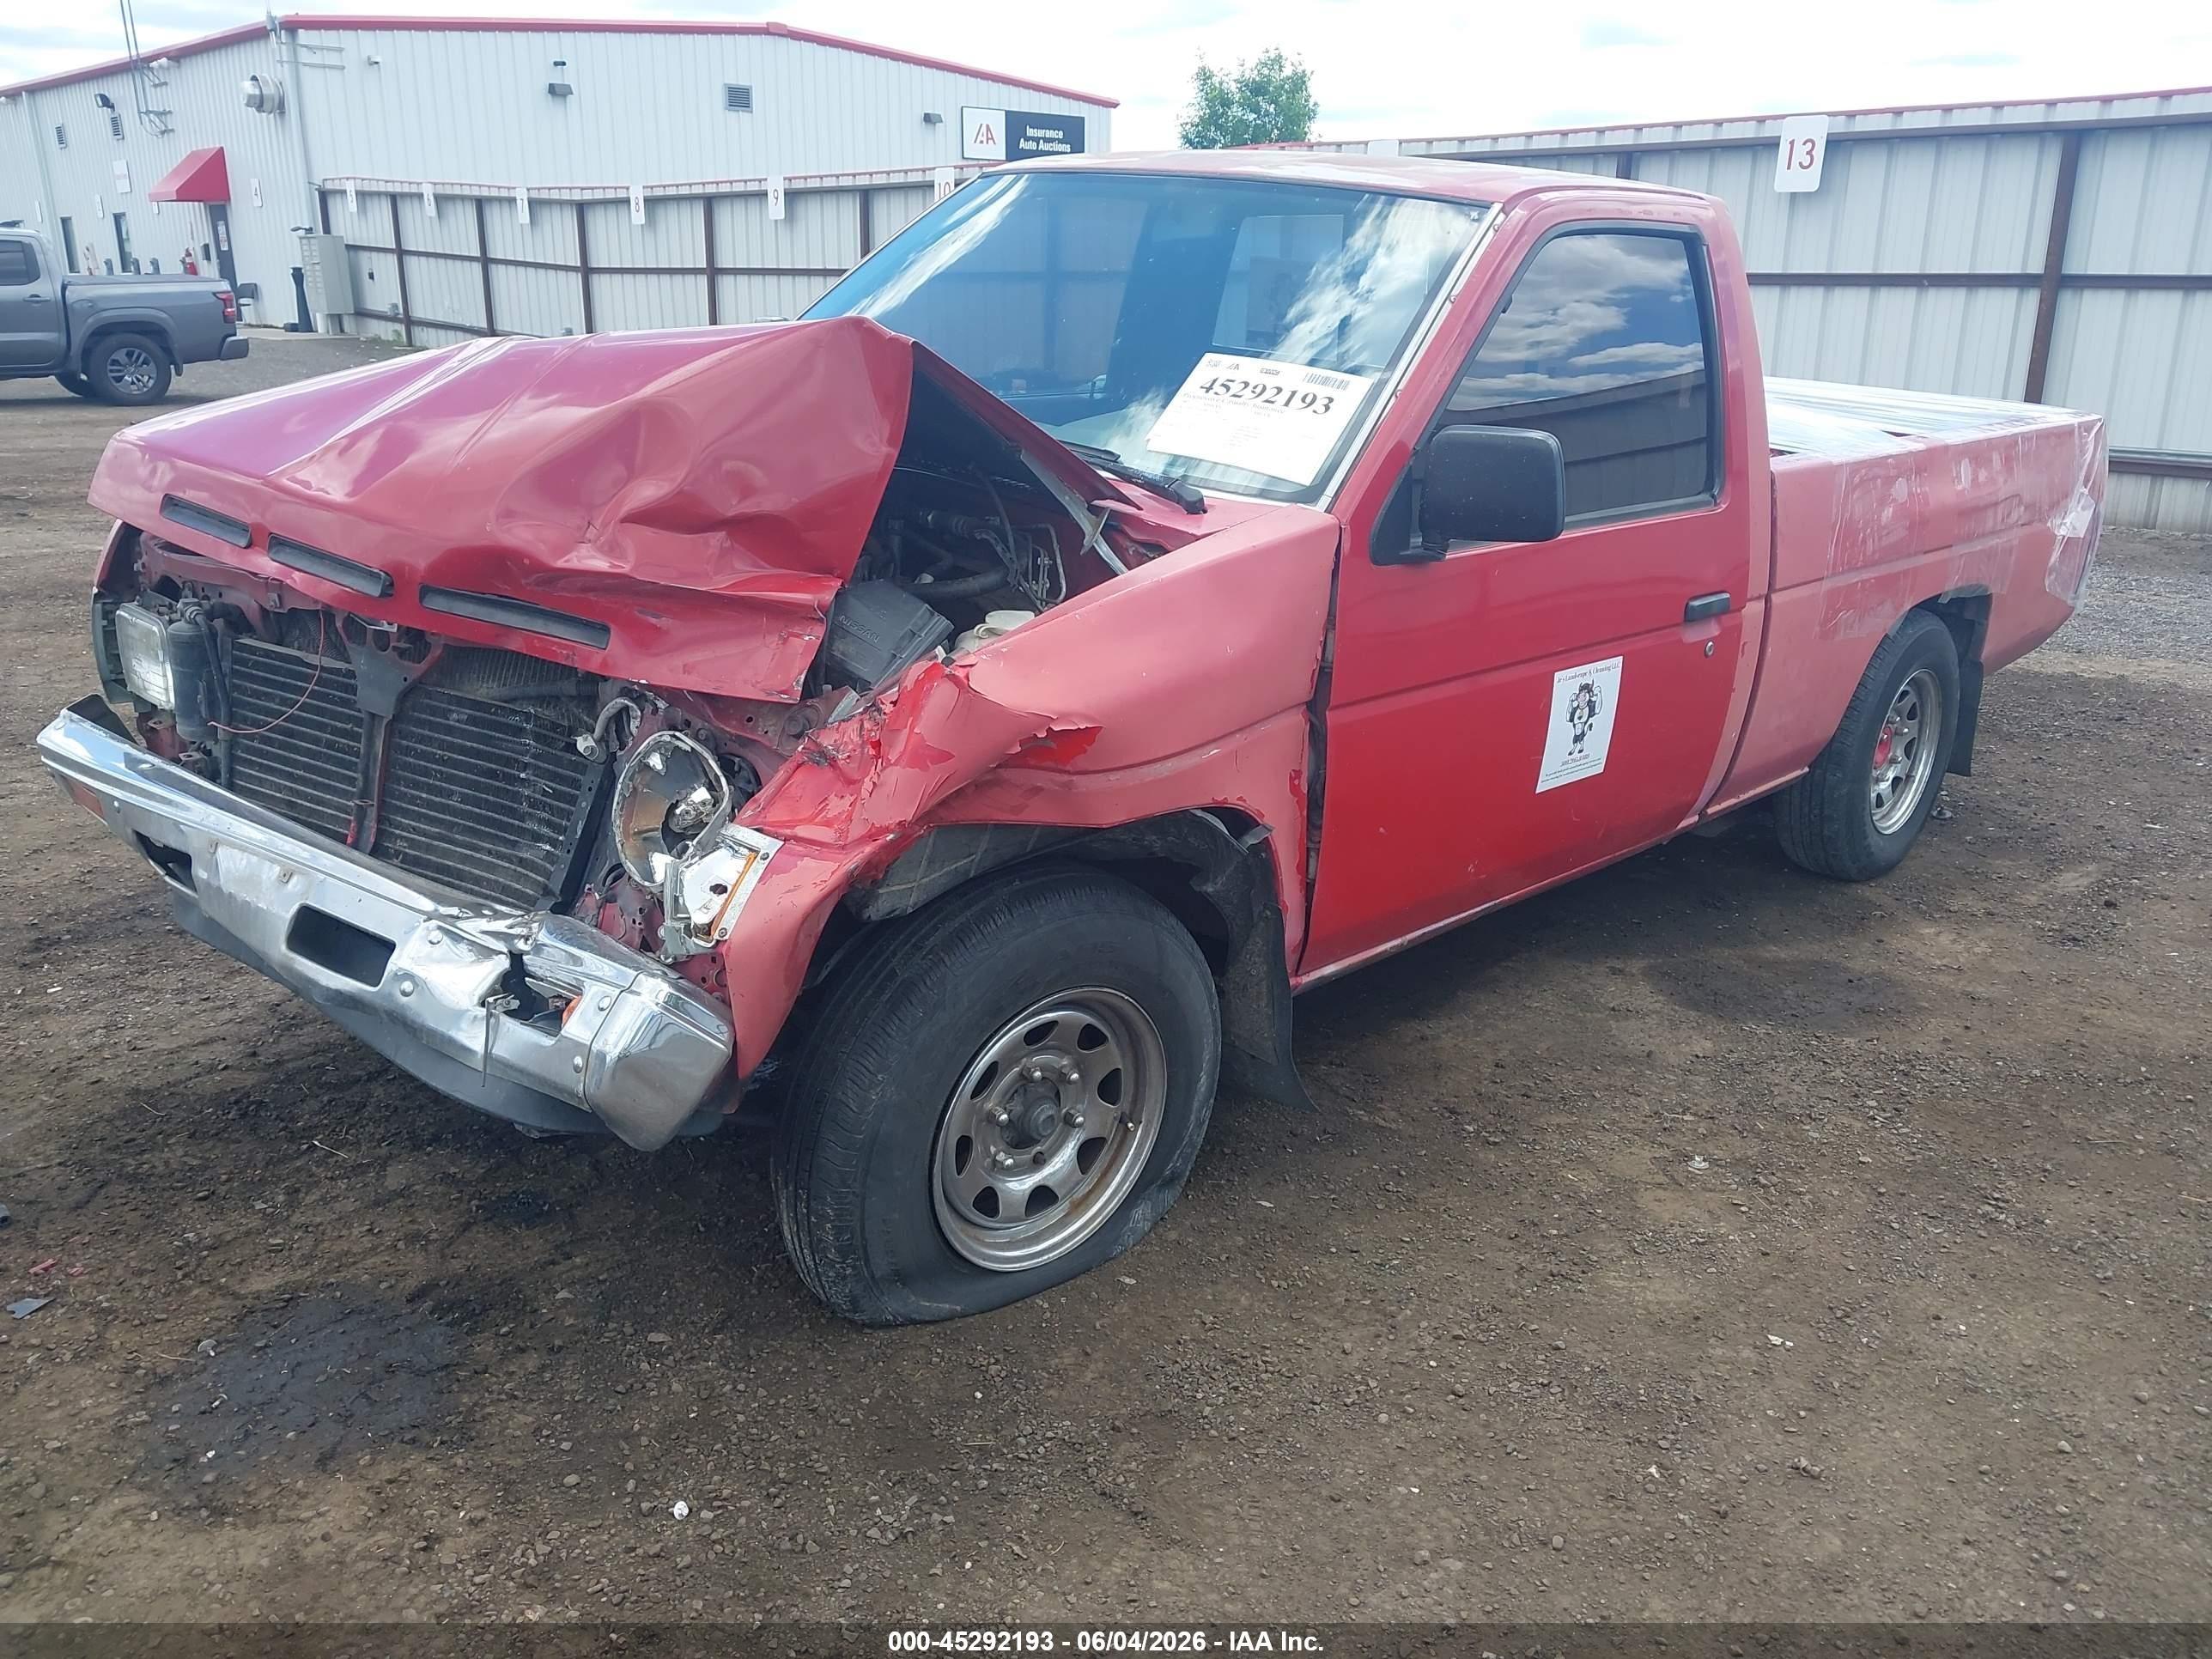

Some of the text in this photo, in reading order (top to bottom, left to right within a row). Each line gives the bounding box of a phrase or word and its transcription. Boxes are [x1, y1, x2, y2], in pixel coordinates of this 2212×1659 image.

[1026, 125, 1064, 139] Insurance
[1018, 137, 1071, 153] Auto Auctions
[1786, 137, 1816, 171] 13
[253, 185, 258, 199] 4
[773, 188, 780, 206] 9
[519, 198, 525, 214] 7
[634, 196, 641, 213] 8
[1199, 376, 1335, 416] 45292193
[839, 614, 880, 643] NISSAN
